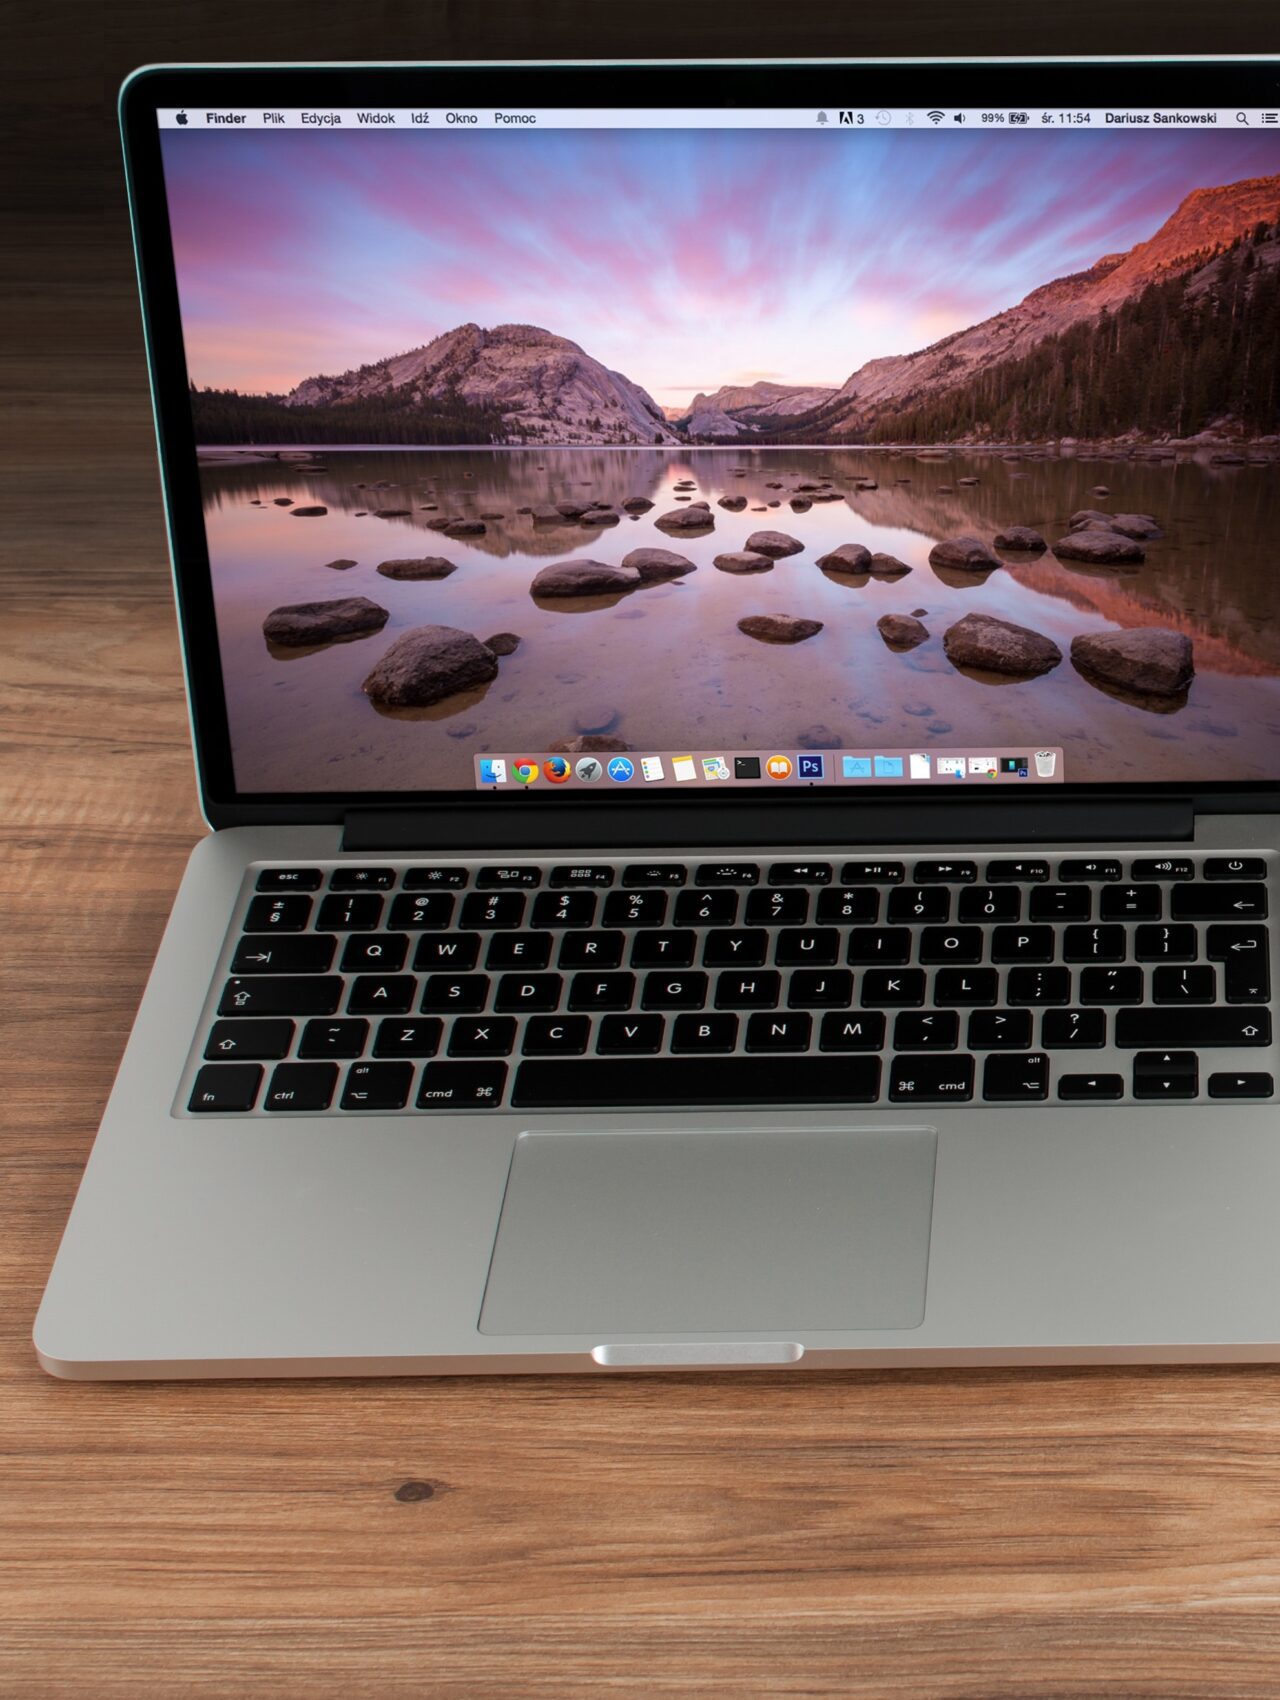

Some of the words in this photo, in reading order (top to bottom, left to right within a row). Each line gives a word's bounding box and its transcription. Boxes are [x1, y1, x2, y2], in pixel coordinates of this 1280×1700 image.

[206, 112, 247, 124] Finder
[262, 112, 286, 124] Plik
[300, 112, 342, 127] Edycja
[356, 112, 396, 124] Widok
[411, 111, 430, 124] Idź
[445, 112, 478, 124] Okno
[494, 112, 537, 124] Pomoc
[856, 113, 865, 125] 3
[981, 112, 1005, 123] 99%
[1041, 111, 1055, 124] śr.
[1058, 112, 1091, 124] 11:54
[1105, 112, 1150, 124] Dariusz
[1152, 112, 1217, 124] Sankowski
[803, 760, 819, 773] Ps
[701, 893, 713, 901] ^
[771, 893, 784, 903] &
[917, 891, 923, 901] (
[988, 890, 993, 900] )
[1126, 889, 1137, 897] +
[348, 898, 354, 909] !
[414, 897, 430, 907] @
[488, 896, 499, 906] #
[559, 895, 570, 906] $
[628, 894, 644, 905] %
[412, 910, 425, 921] 2
[484, 909, 496, 920] 3
[555, 908, 567, 919] 4
[628, 908, 639, 919] 5
[699, 906, 710, 917] 6
[771, 906, 782, 916] 7
[841, 904, 853, 915] 8
[913, 904, 925, 915] 9
[269, 912, 281, 923] §
[344, 911, 351, 922] 1
[1092, 928, 1099, 940] {
[1163, 927, 1170, 939] }
[585, 942, 598, 954] R
[658, 940, 670, 952] T
[730, 940, 743, 952] Y
[800, 939, 815, 950] U
[877, 938, 882, 950] I
[943, 937, 960, 949] O
[1017, 936, 1030, 948] P
[1093, 942, 1098, 954] [
[1163, 941, 1169, 953] ]
[366, 944, 382, 957] Q
[438, 944, 457, 956] W
[513, 943, 525, 955] E
[596, 983, 608, 995] F
[666, 982, 682, 994] G
[740, 981, 756, 993] H
[815, 981, 826, 993] J
[887, 979, 901, 991] K
[961, 979, 972, 990] L
[1180, 984, 1189, 994] \
[372, 986, 388, 998] A
[448, 985, 461, 998] S
[520, 985, 536, 997] D
[1070, 1013, 1080, 1024] ?
[400, 1029, 415, 1041] Z
[474, 1028, 490, 1040] X
[549, 1027, 564, 1039] C
[624, 1026, 639, 1038] V
[698, 1025, 711, 1037] B
[771, 1023, 787, 1036] N
[843, 1023, 862, 1035] M
[1027, 1056, 1041, 1064] alt
[938, 1081, 966, 1091] cmd
[202, 1092, 215, 1101] fn
[274, 1091, 295, 1100] ctrl
[425, 1089, 454, 1098] cmd
